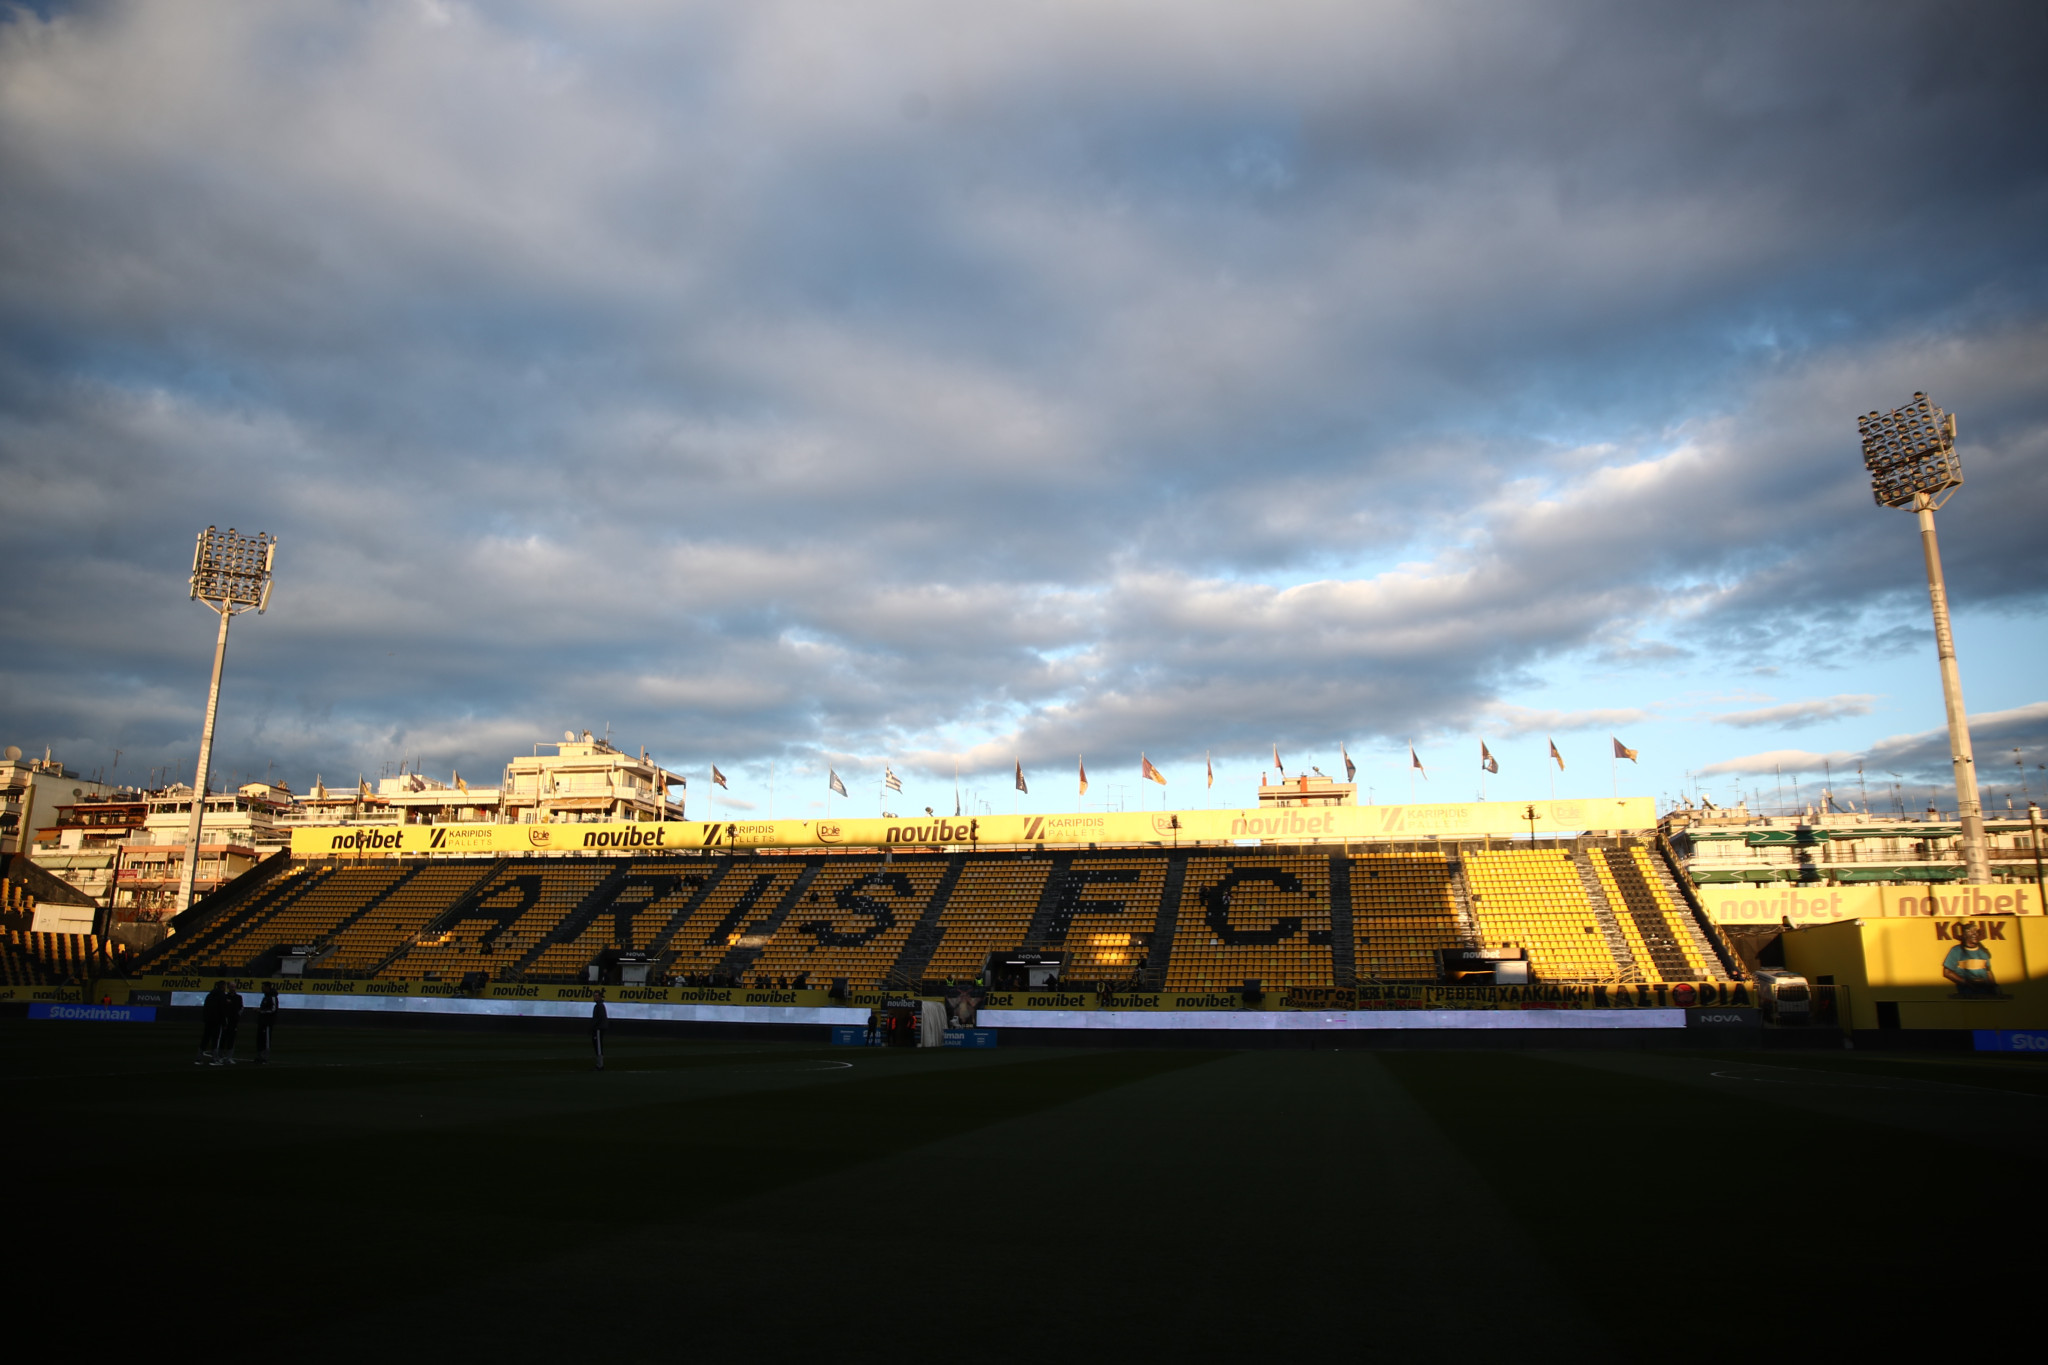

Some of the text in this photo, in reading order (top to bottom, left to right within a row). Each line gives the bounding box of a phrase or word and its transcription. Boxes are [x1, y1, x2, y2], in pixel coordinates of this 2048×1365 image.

[1928, 582, 1953, 653] novibet
[1407, 808, 1469, 819] KARIPIDIS
[821, 825, 840, 835] Dole
[886, 819, 979, 842] novibet
[1048, 818, 1105, 828] KARIPIDIS
[1231, 811, 1335, 835] novibet
[331, 829, 404, 849] novibet
[449, 829, 492, 838] KARIPIDIS
[533, 830, 550, 840] Dole
[583, 825, 666, 847] novibet
[1048, 829, 1105, 837] PALLETS
[1719, 887, 2029, 920] novibet novibet
[1462, 949, 1501, 959] novibet
[162, 977, 202, 988] novibet
[269, 979, 303, 991] ovibet
[312, 981, 355, 992] novibet
[366, 982, 409, 993] novibet
[421, 983, 463, 994] novibe
[493, 985, 539, 997] novibet
[558, 986, 606, 998] novibt
[619, 987, 668, 1000] novibet
[681, 989, 732, 1002] novibet
[746, 990, 797, 1003] novibet
[1425, 986, 1497, 1003] ΓΡΕΒΕΝΑ
[1499, 985, 1589, 1002] ΧΑΛΚΙΔΙΚΗ
[887, 999, 916, 1008] novibet
[984, 993, 1236, 1008] ibet novibet novibet novibet
[49, 1003, 131, 1020] Stoiximan
[1701, 1014, 1743, 1024] NOVA
